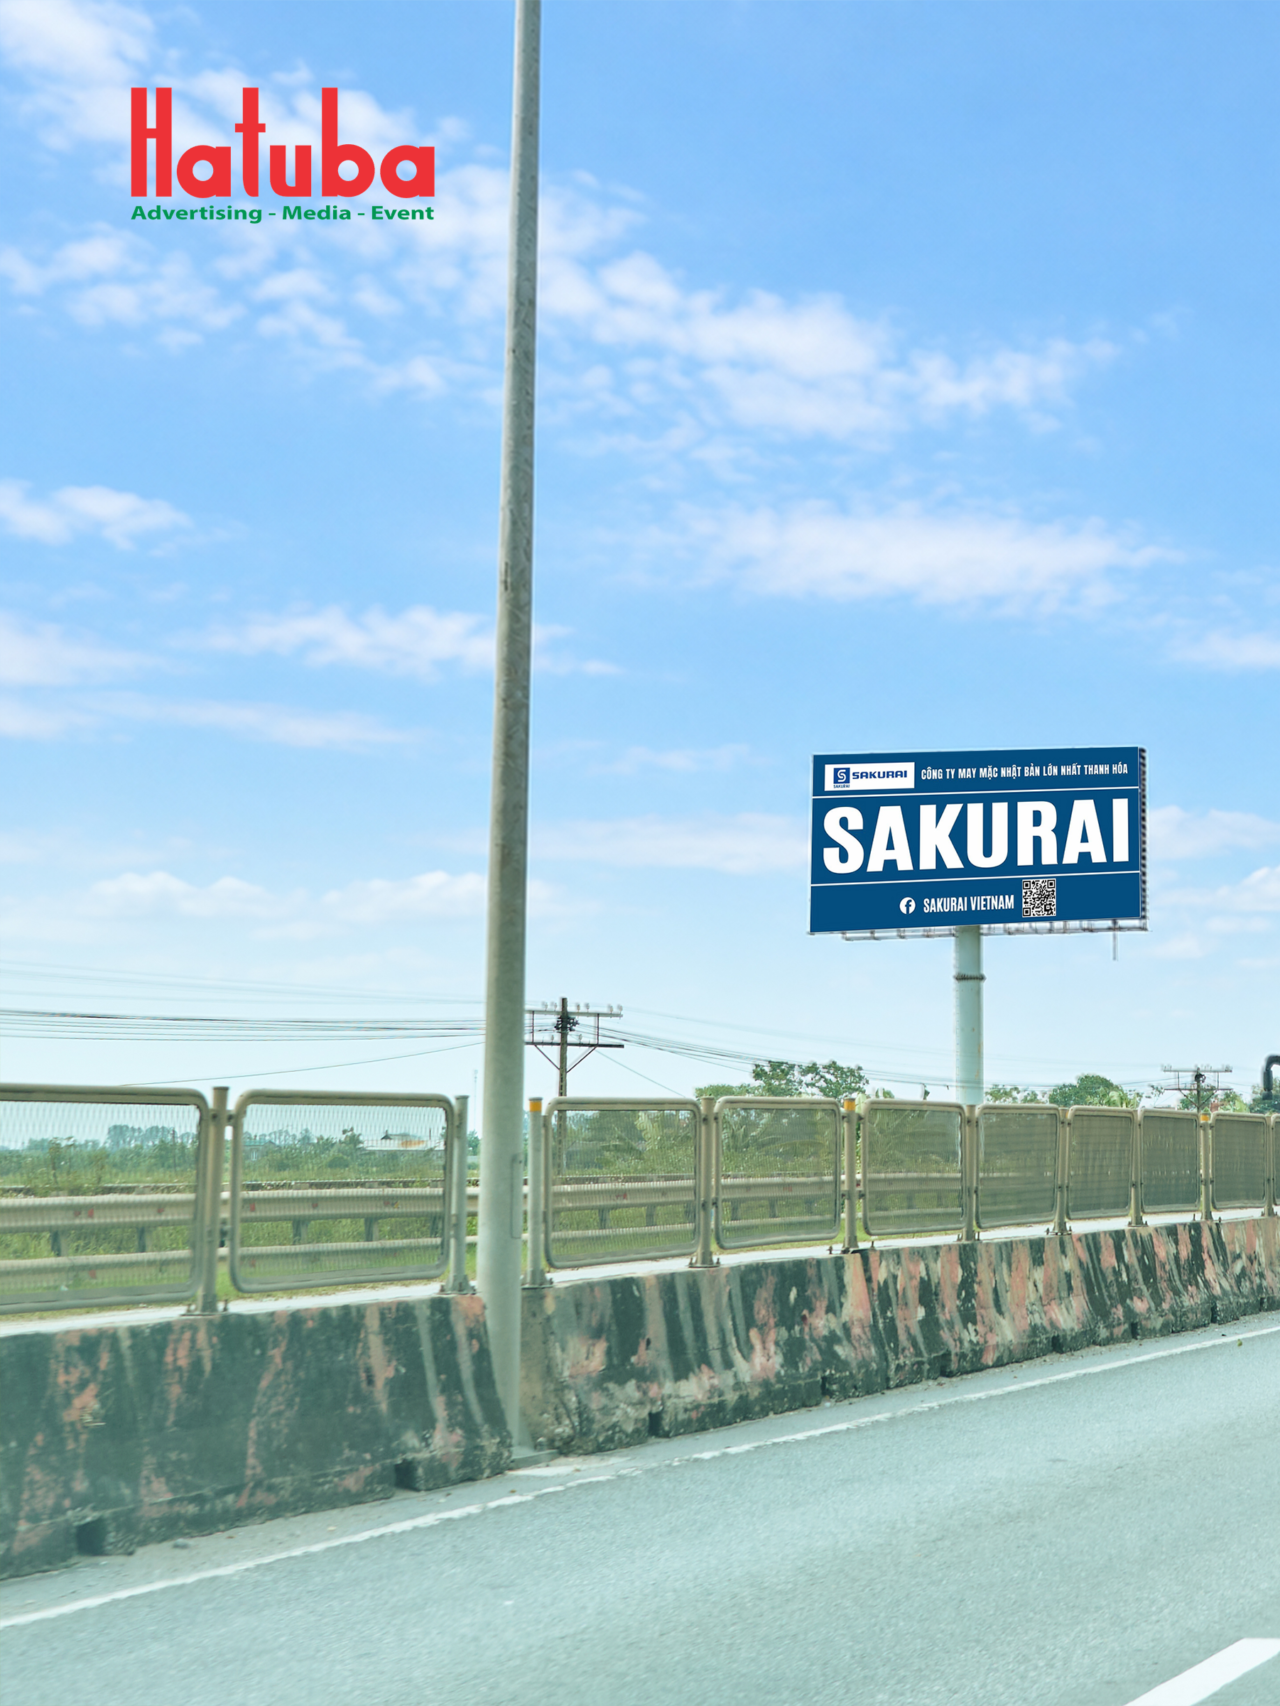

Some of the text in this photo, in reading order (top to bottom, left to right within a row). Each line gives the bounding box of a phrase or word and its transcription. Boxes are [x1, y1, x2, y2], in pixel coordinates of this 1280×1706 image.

[852, 770, 907, 780] SAKURAI
[921, 767, 943, 780] CÔNG
[945, 768, 955, 779] TY
[958, 768, 977, 779] MAY
[979, 765, 998, 780] MẶC
[1000, 764, 1021, 780] NHẬT
[1024, 763, 1040, 777] BẢN
[1061, 762, 1081, 776] NHẤT
[1084, 763, 1110, 775] THANH
[1112, 761, 1128, 774] HÓA
[823, 798, 1129, 874] SAKURAI
[923, 895, 1014, 913] SAKURAI VIETNAM
